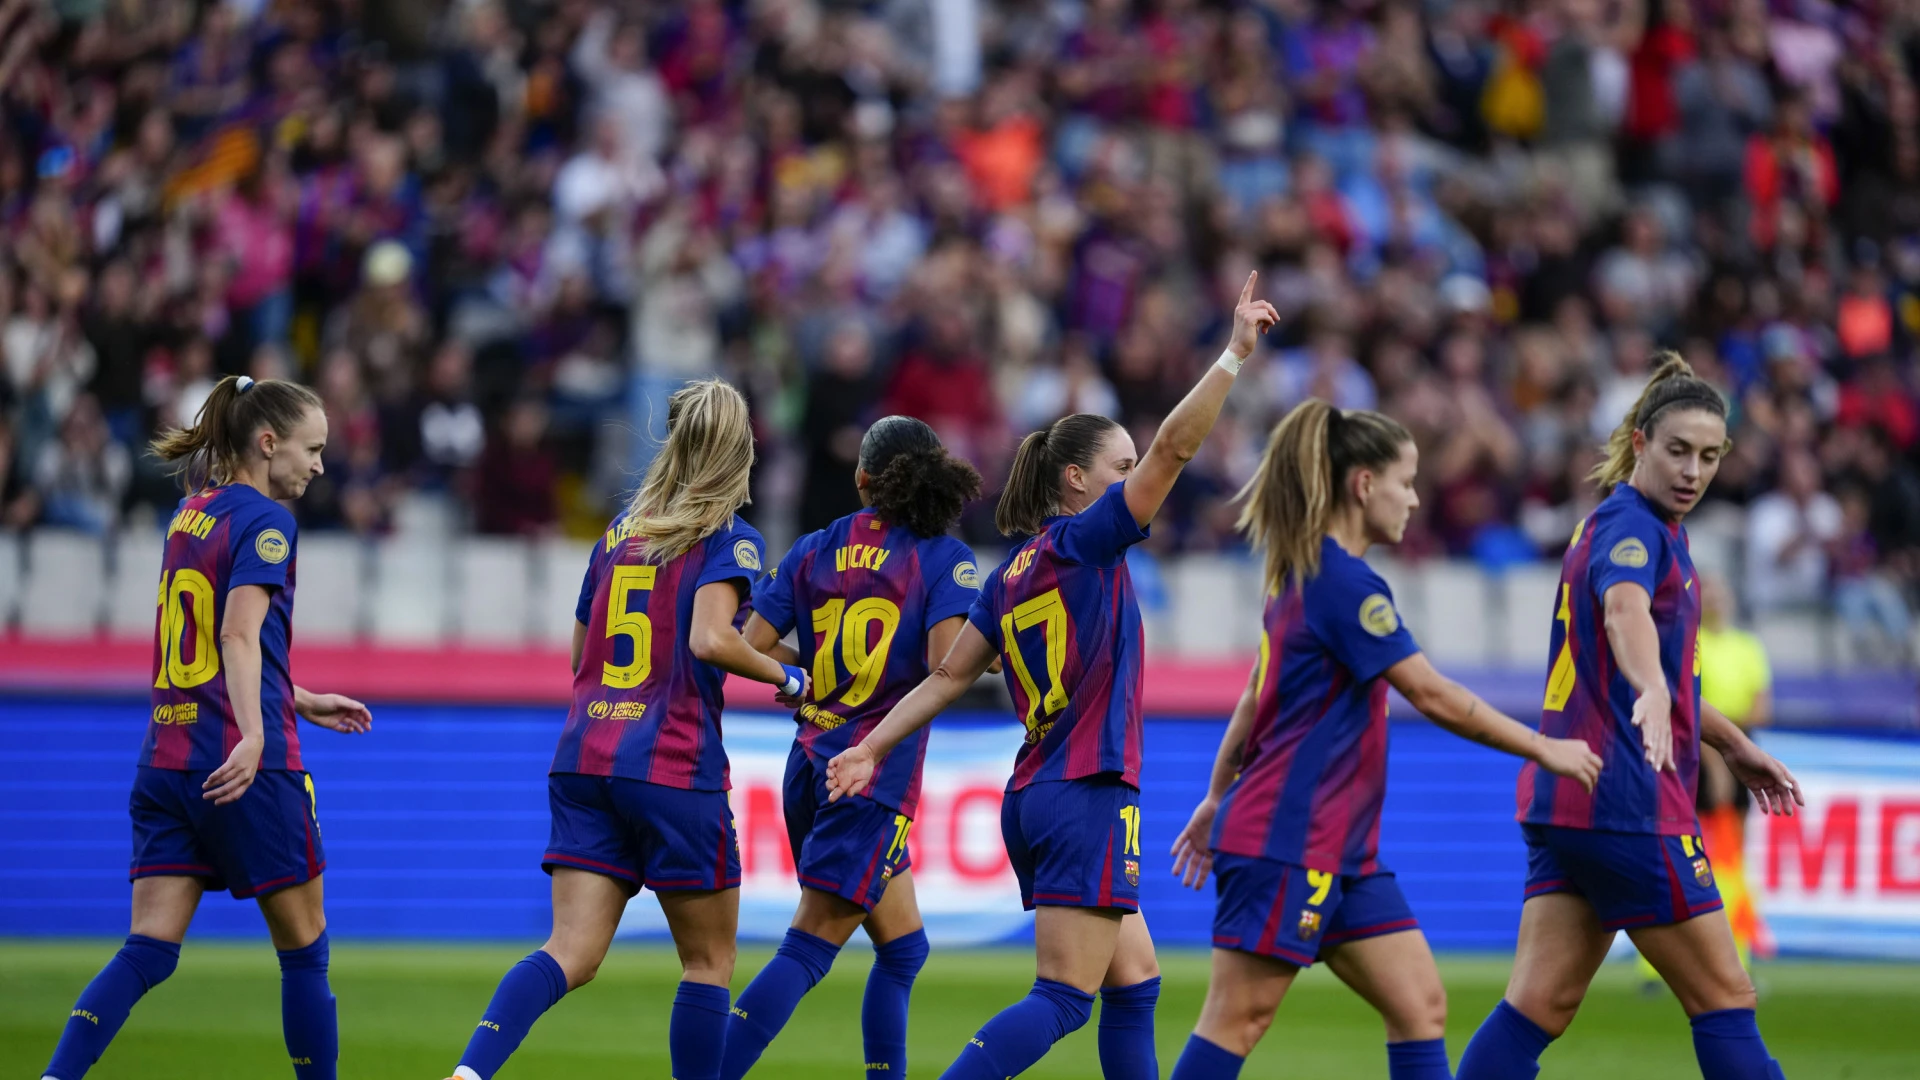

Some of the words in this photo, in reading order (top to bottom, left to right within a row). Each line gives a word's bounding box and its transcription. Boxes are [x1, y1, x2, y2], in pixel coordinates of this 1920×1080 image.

[154, 568, 220, 689] 10
[601, 565, 657, 689] 5
[812, 597, 900, 707] 19
[1001, 588, 1069, 732] 17
[610, 709, 643, 718] ACNUR
[614, 701, 647, 712] UNHCR
[1306, 868, 1334, 907] 9
